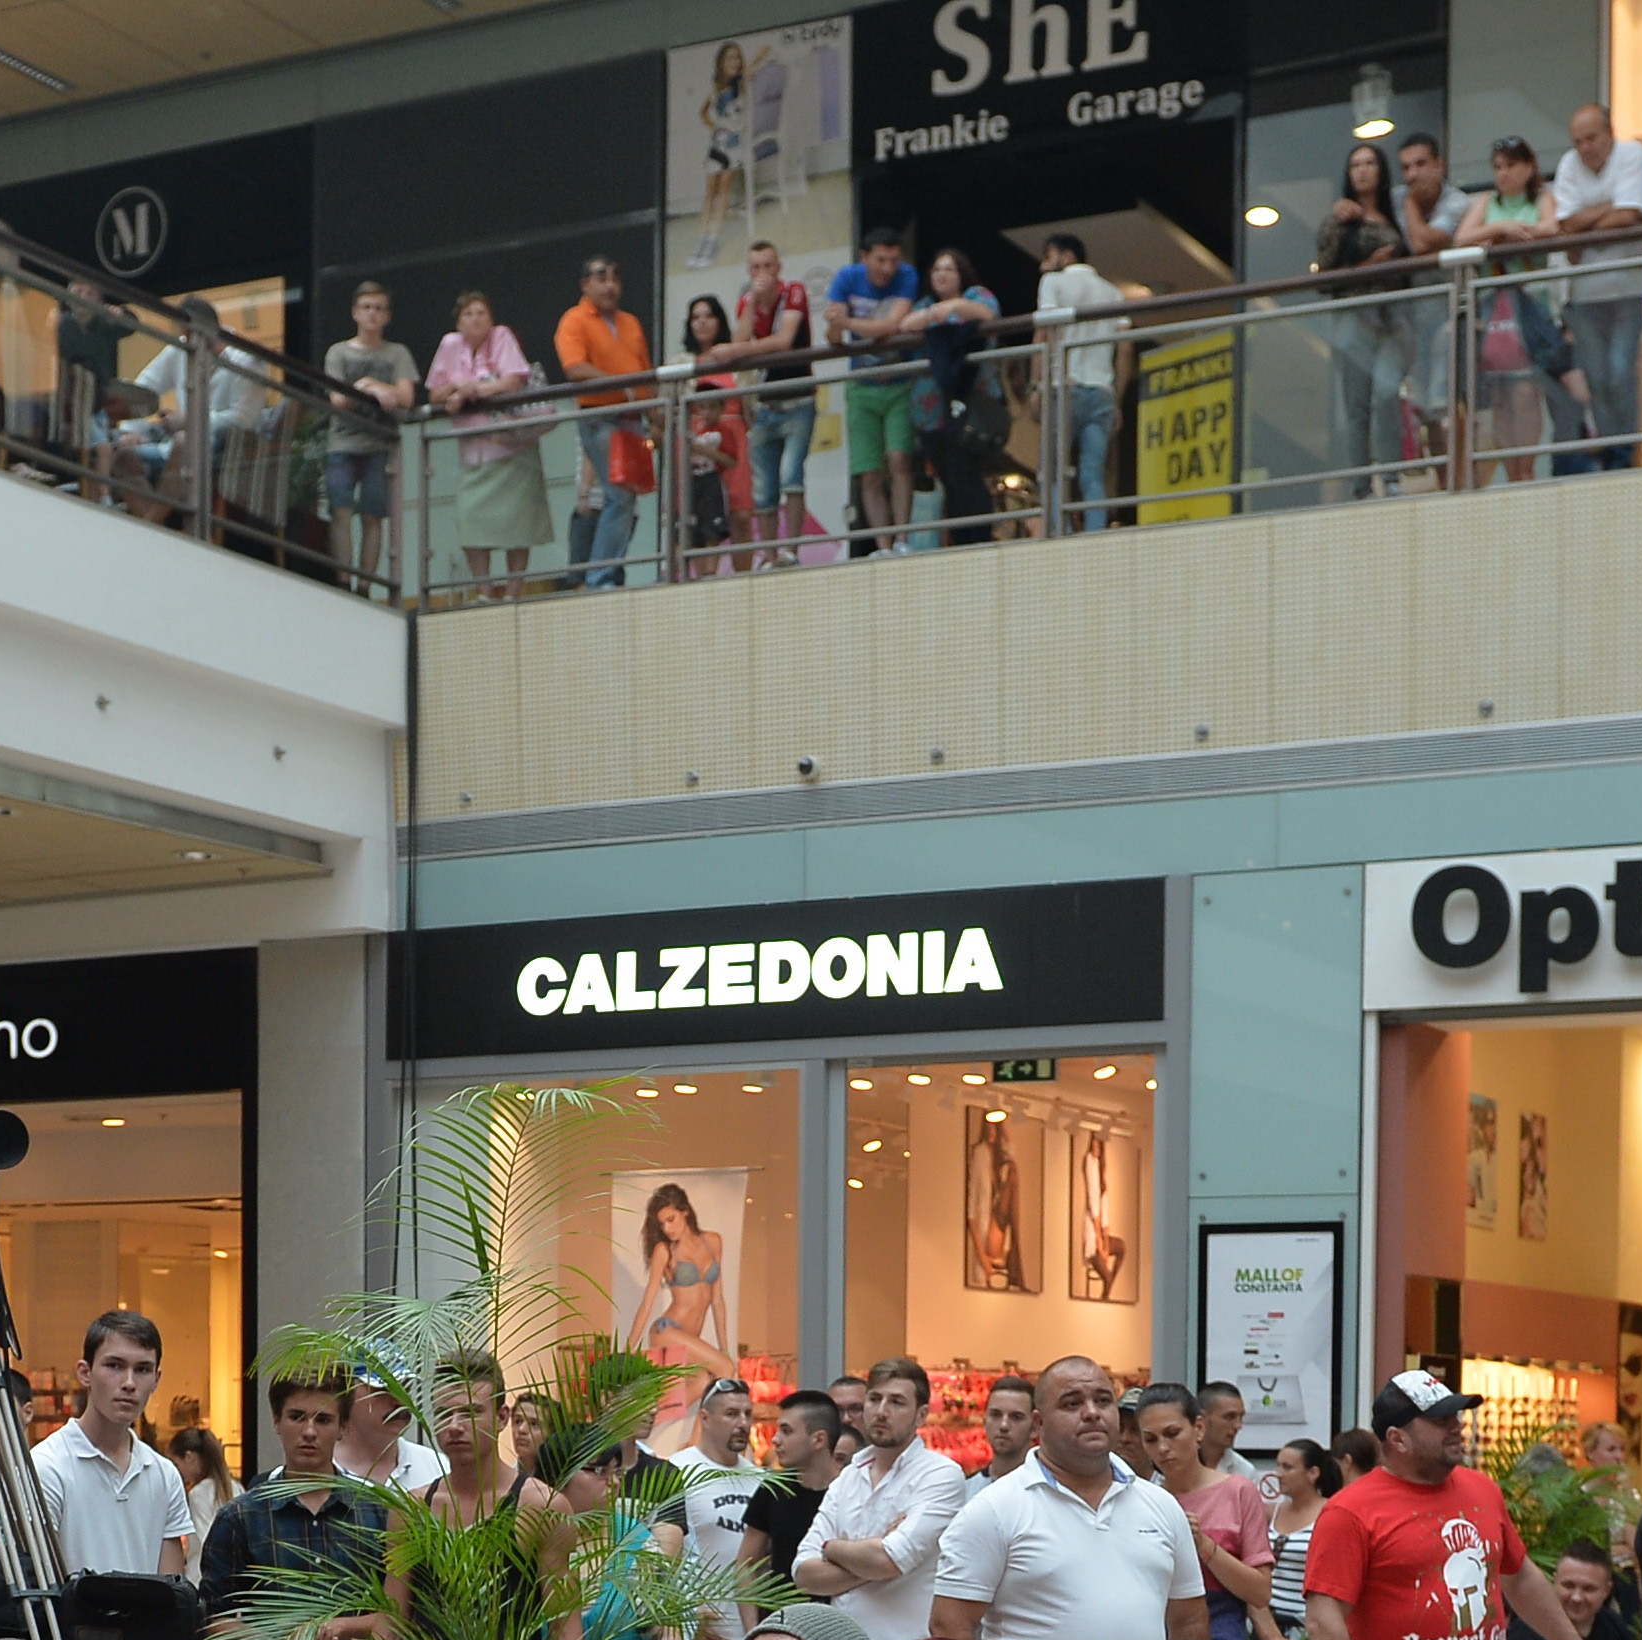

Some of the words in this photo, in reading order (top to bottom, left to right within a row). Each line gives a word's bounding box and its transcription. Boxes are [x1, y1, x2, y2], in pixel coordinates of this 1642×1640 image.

[930, 0, 1149, 97] ShE
[874, 108, 1010, 162] Frankie
[1067, 79, 1205, 127] Garage
[1168, 438, 1225, 486] DAY
[516, 926, 1004, 1017] CALZEDONIA
[1235, 1268, 1279, 1283] MALL
[1281, 1268, 1303, 1282] OF
[1235, 1282, 1303, 1293] CONSTANTA
